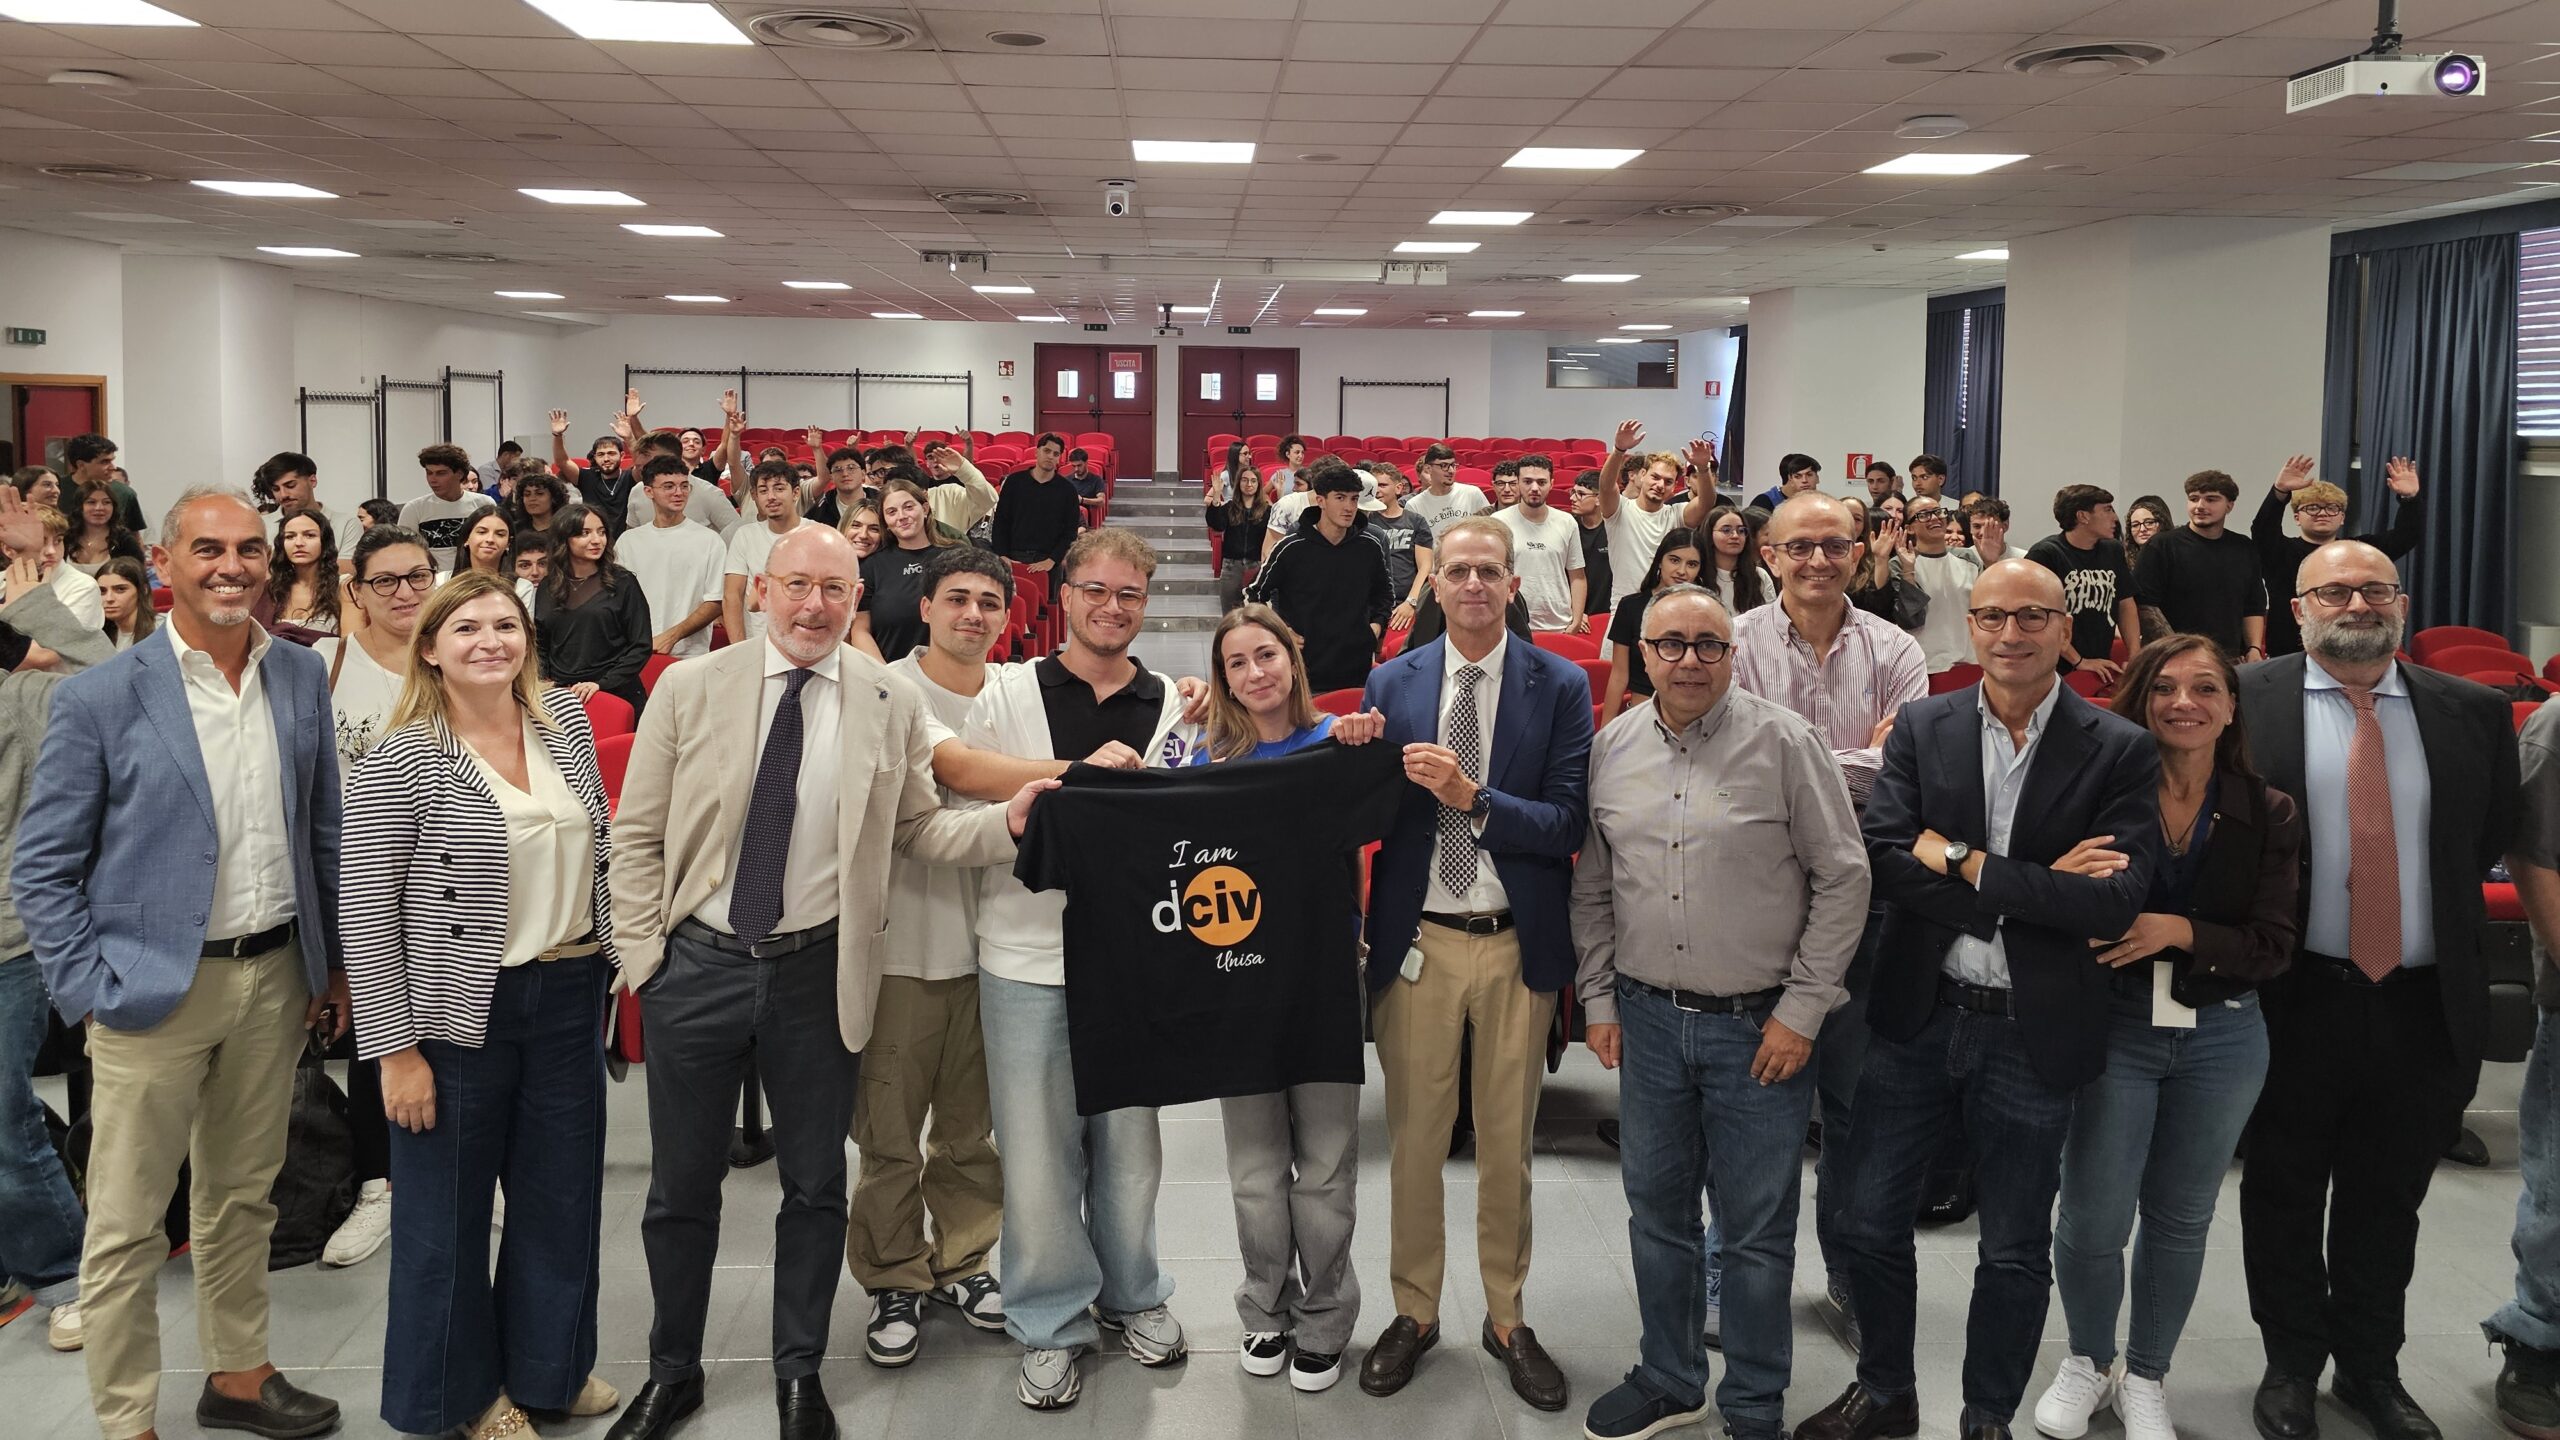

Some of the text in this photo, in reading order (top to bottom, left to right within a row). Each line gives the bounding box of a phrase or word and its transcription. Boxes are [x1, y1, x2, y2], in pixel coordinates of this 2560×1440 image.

[1383, 528, 1414, 550] IKE
[903, 565, 923, 576] NYC
[1169, 840, 1238, 869] I am
[1151, 879, 1260, 934] dciv
[1215, 950, 1265, 973] Unisa
